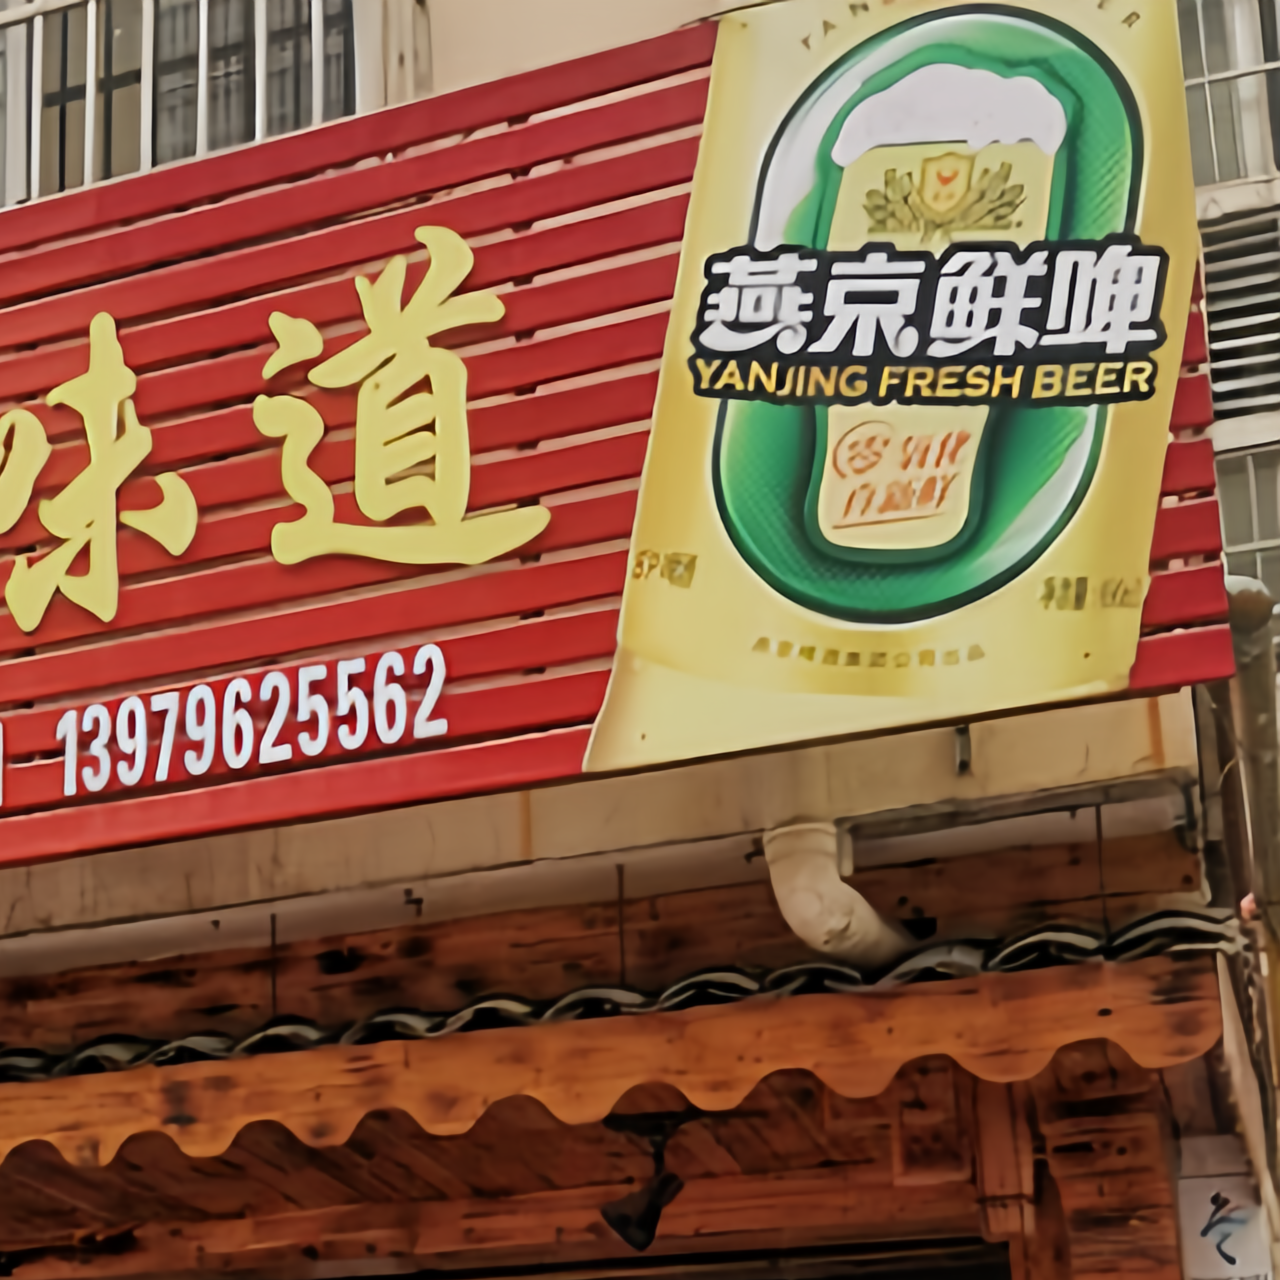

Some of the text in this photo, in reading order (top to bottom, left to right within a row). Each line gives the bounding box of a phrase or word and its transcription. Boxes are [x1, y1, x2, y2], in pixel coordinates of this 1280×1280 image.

[699, 244, 1161, 358] 燕京鲜啤
[695, 358, 1154, 399] YANJING FRESH BEER
[56, 643, 448, 796] 13979625562
